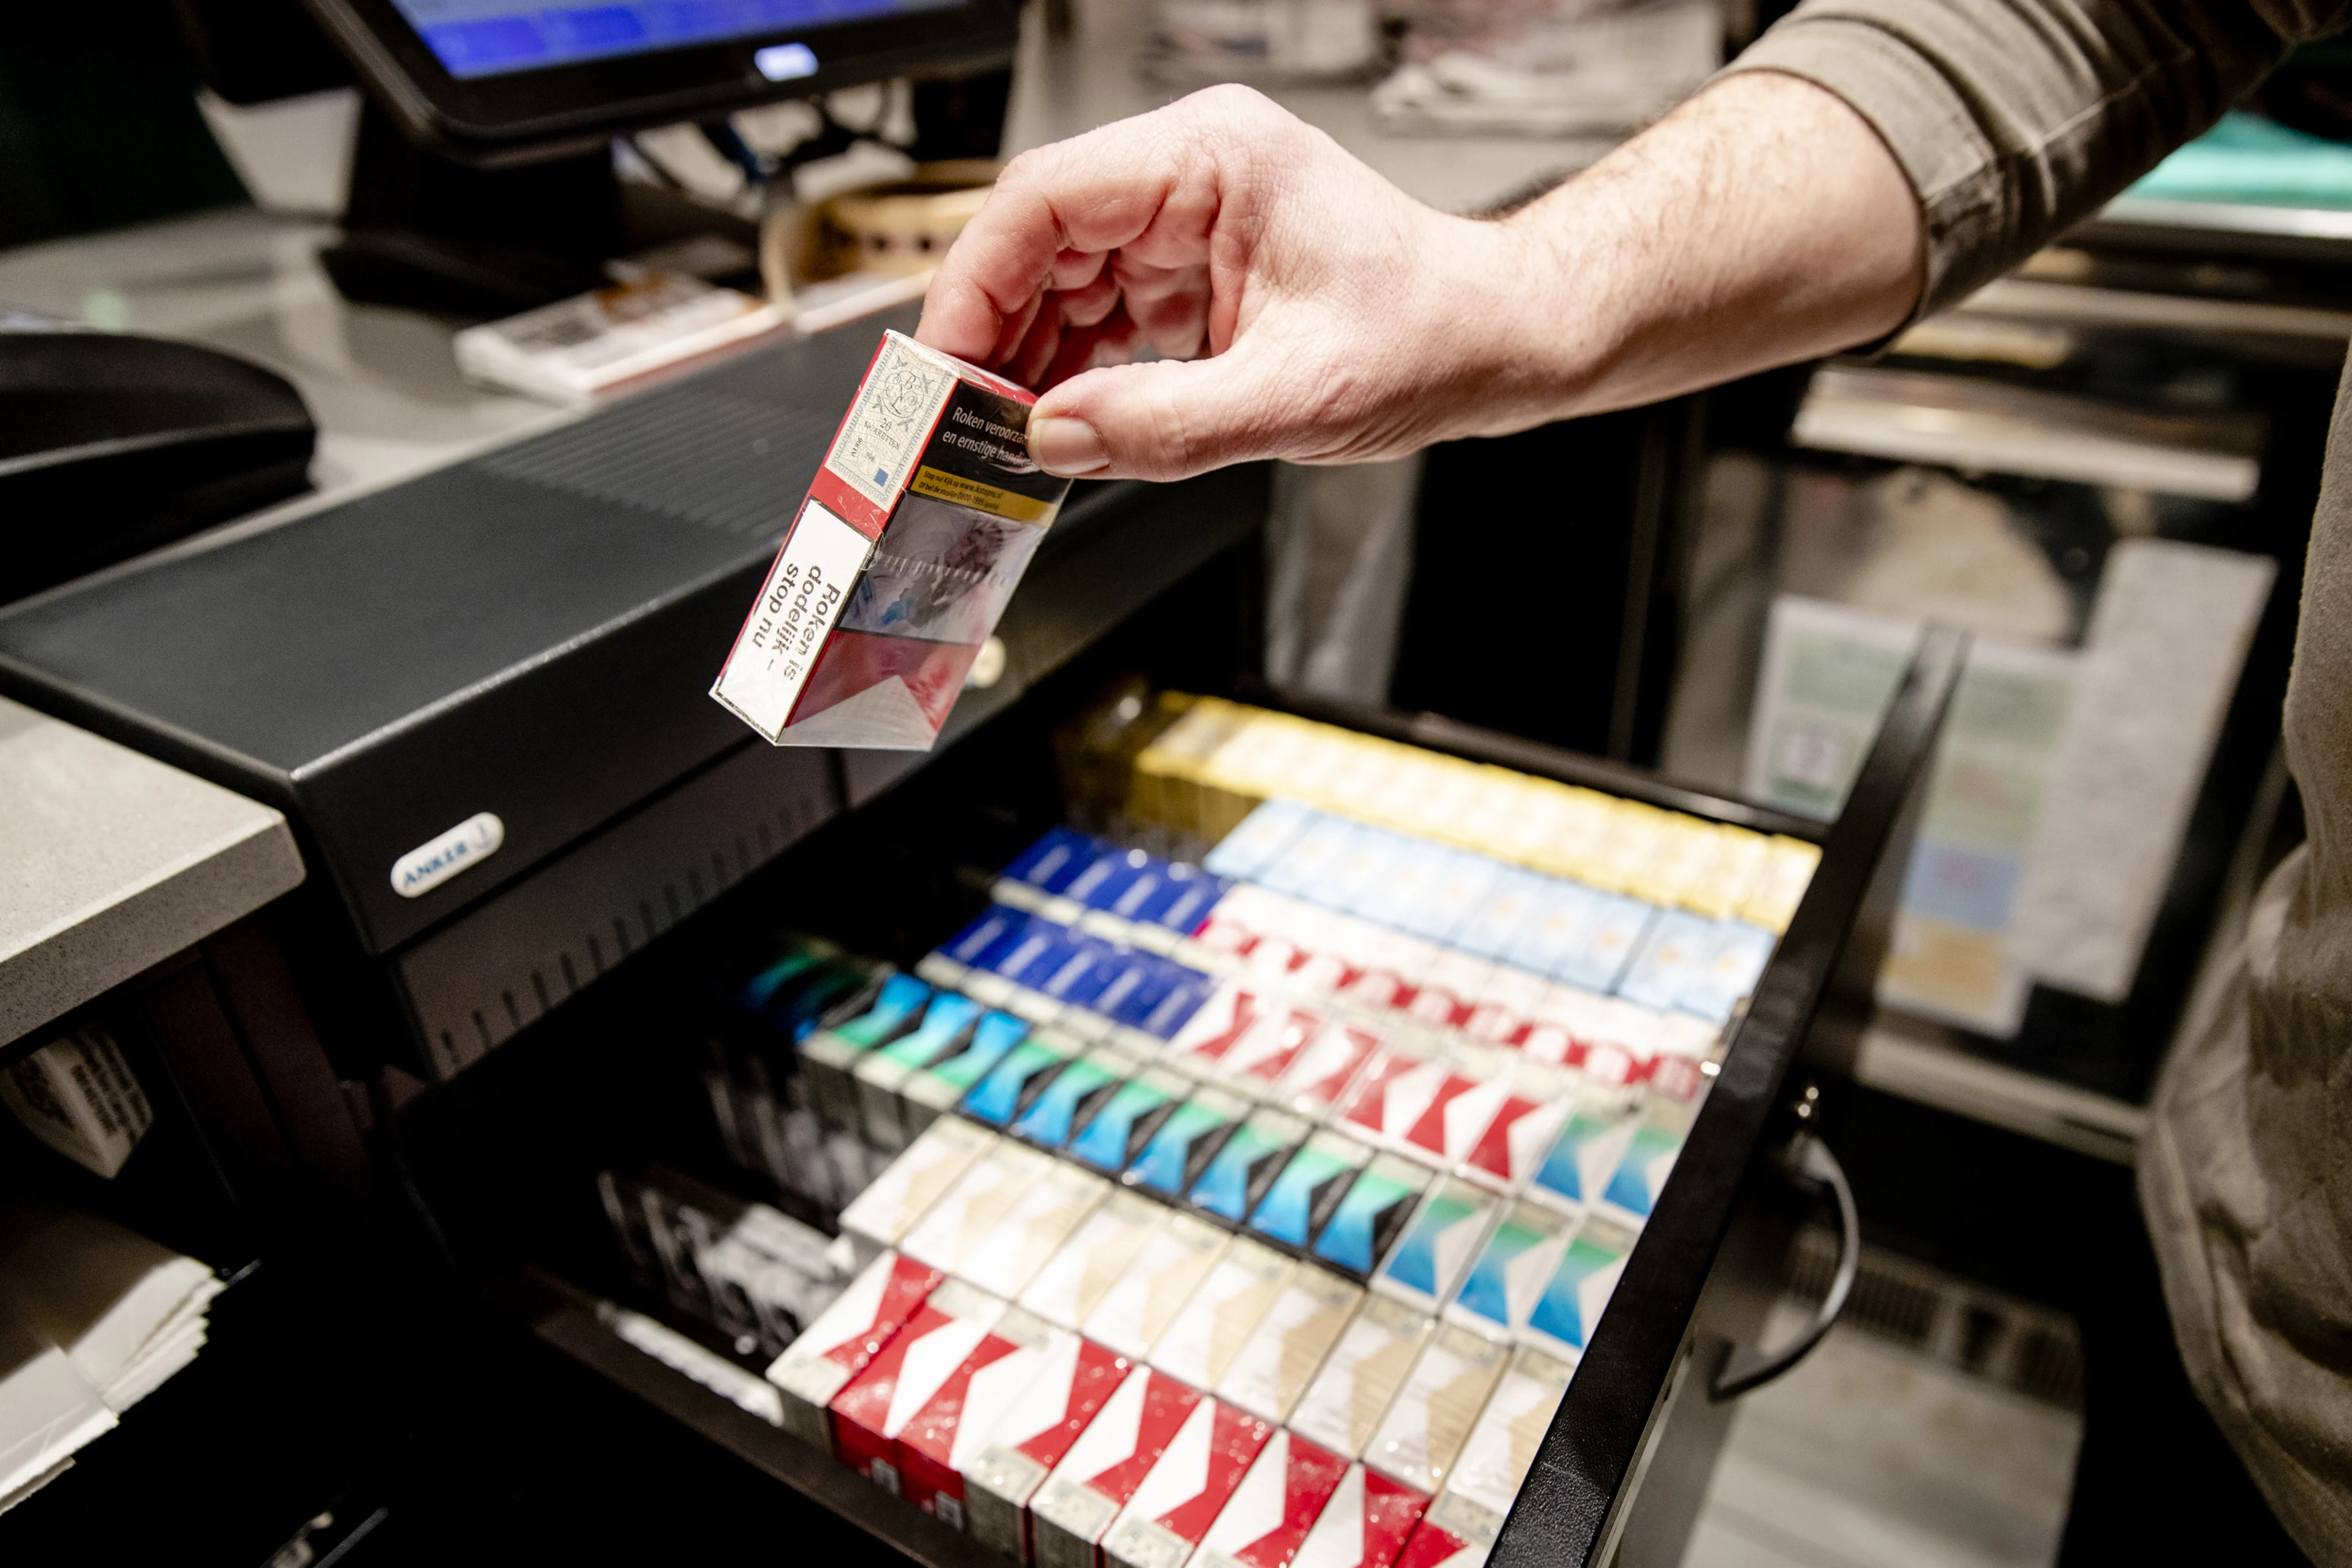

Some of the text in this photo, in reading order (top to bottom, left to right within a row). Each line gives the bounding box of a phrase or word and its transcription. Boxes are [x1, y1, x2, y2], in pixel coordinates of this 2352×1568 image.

[880, 418, 892, 431] 20
[952, 407, 984, 429] Roken
[863, 420, 901, 450] SIGARETTEN
[942, 431, 956, 444] en
[957, 437, 997, 459] ernstige
[924, 471, 935, 481] Stop
[944, 477, 953, 486] Kijk
[933, 484, 940, 493] de
[752, 563, 799, 648] stop nu
[772, 565, 821, 655] dodelijk
[784, 583, 841, 680] Roken is
